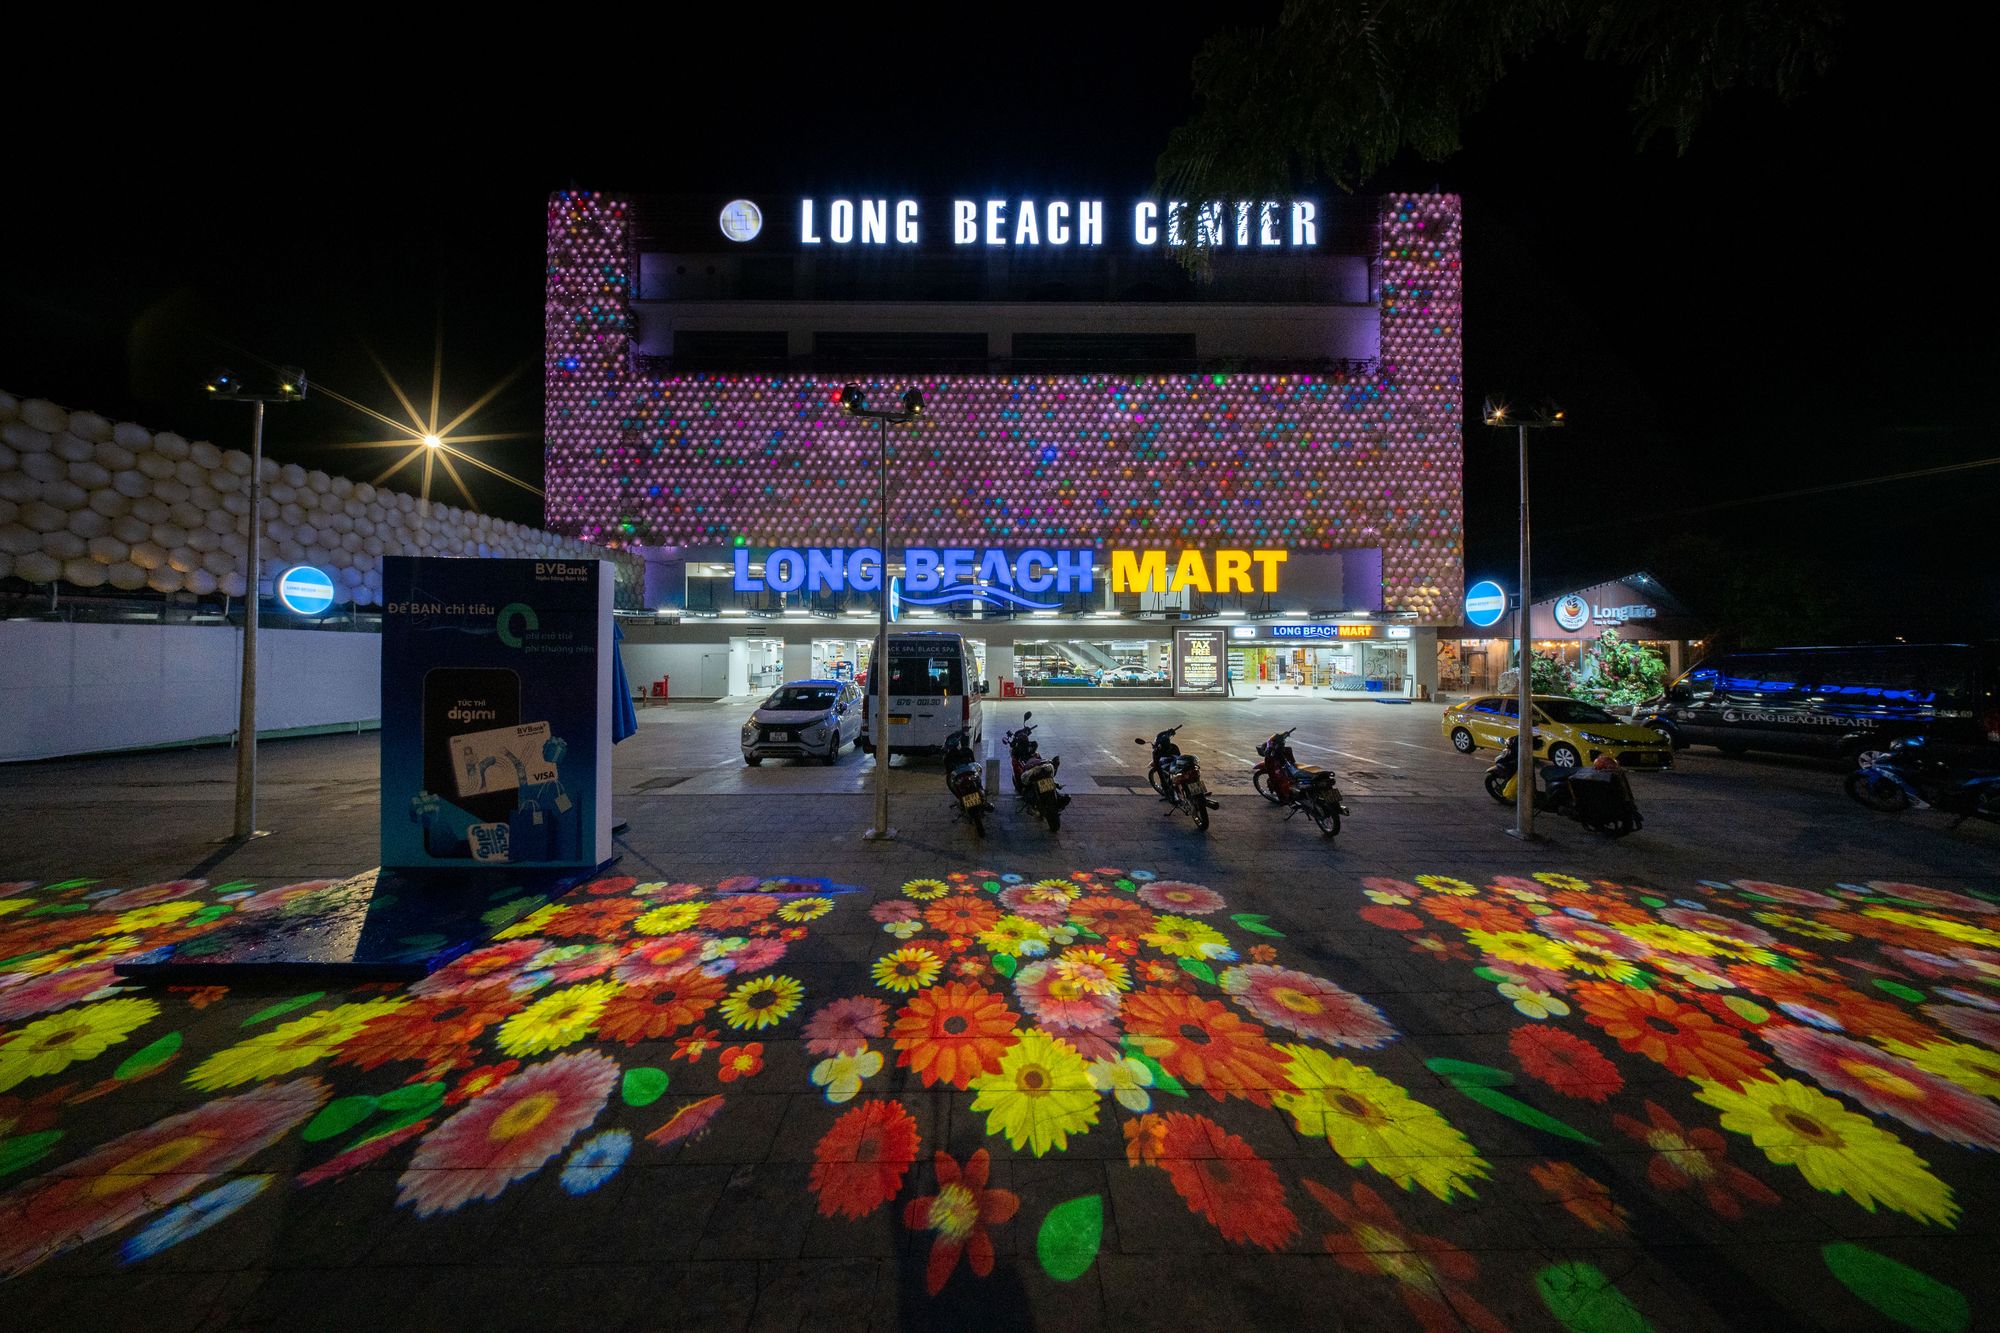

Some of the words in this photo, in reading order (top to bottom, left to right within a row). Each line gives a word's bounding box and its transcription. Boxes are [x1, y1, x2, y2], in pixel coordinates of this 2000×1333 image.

[801, 199, 918, 244] LONG
[955, 200, 1102, 245] BEACH
[1135, 201, 1317, 246] CENTER
[535, 563, 588, 576] BVBank
[733, 547, 881, 593] LONG
[905, 548, 1094, 593] BEACH
[1111, 550, 1288, 593] MART
[411, 603, 441, 617] BẠN
[445, 603, 465, 614] chi
[468, 603, 495, 615] tiêu
[1273, 627, 1301, 636] LONG
[1303, 627, 1338, 636] BEACH
[1339, 626, 1371, 636] MART
[1191, 640, 1210, 648] TAX
[1191, 648, 1210, 656] FREE
[447, 706, 496, 724] digimi
[1742, 714, 1775, 722] LONG
[1777, 714, 1823, 725] BEACH
[1824, 716, 1879, 728] PEARL
[533, 771, 555, 781] VISA
